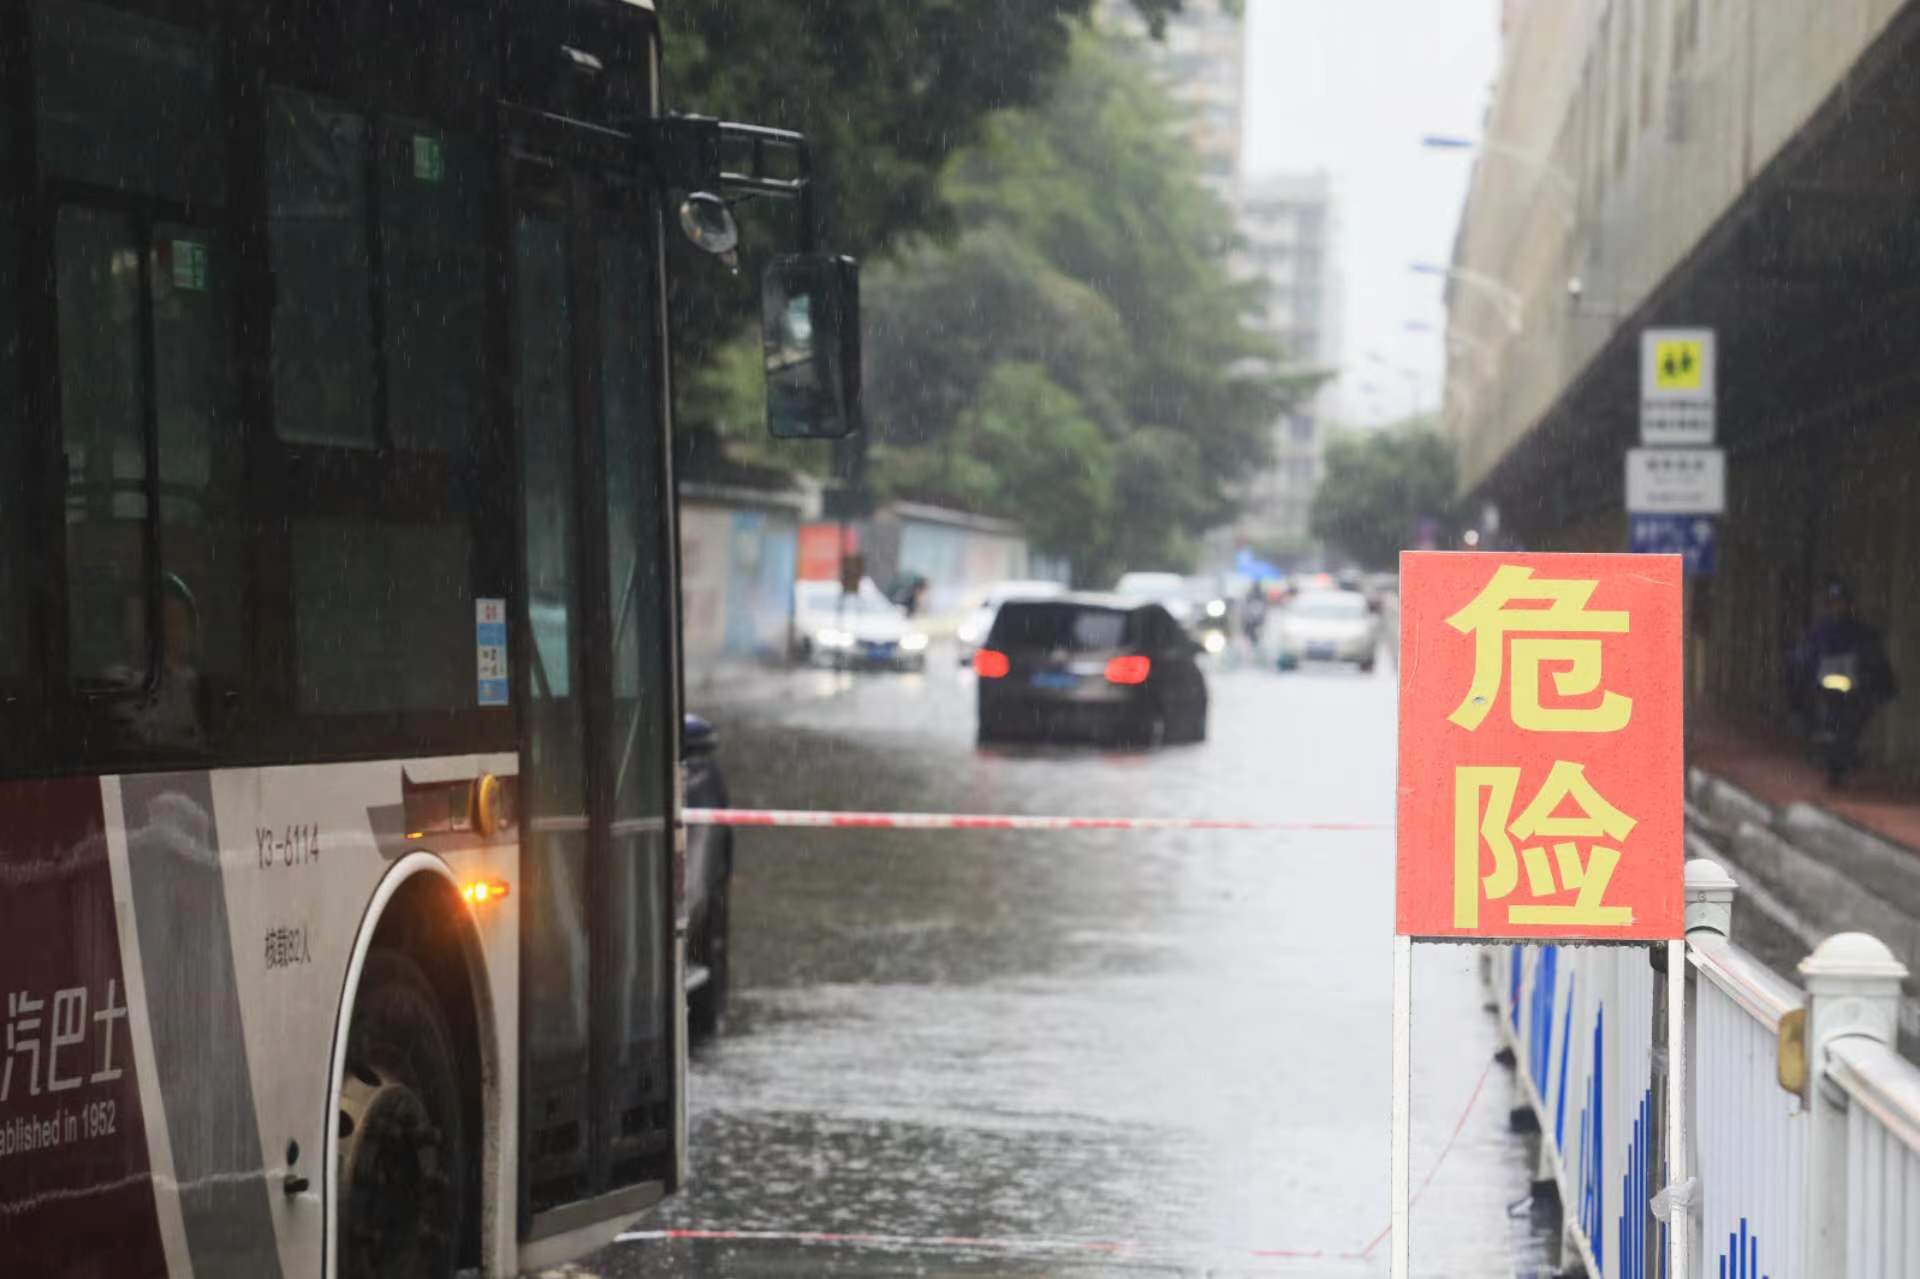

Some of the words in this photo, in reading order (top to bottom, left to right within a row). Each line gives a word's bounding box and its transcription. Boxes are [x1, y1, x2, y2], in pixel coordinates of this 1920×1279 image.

[1445, 564, 1638, 928] 危险
[256, 822, 319, 869] Y3-6114
[0, 978, 128, 1101] 汽巴士
[65, 1108, 77, 1142] in
[82, 1100, 116, 1139] 1952
